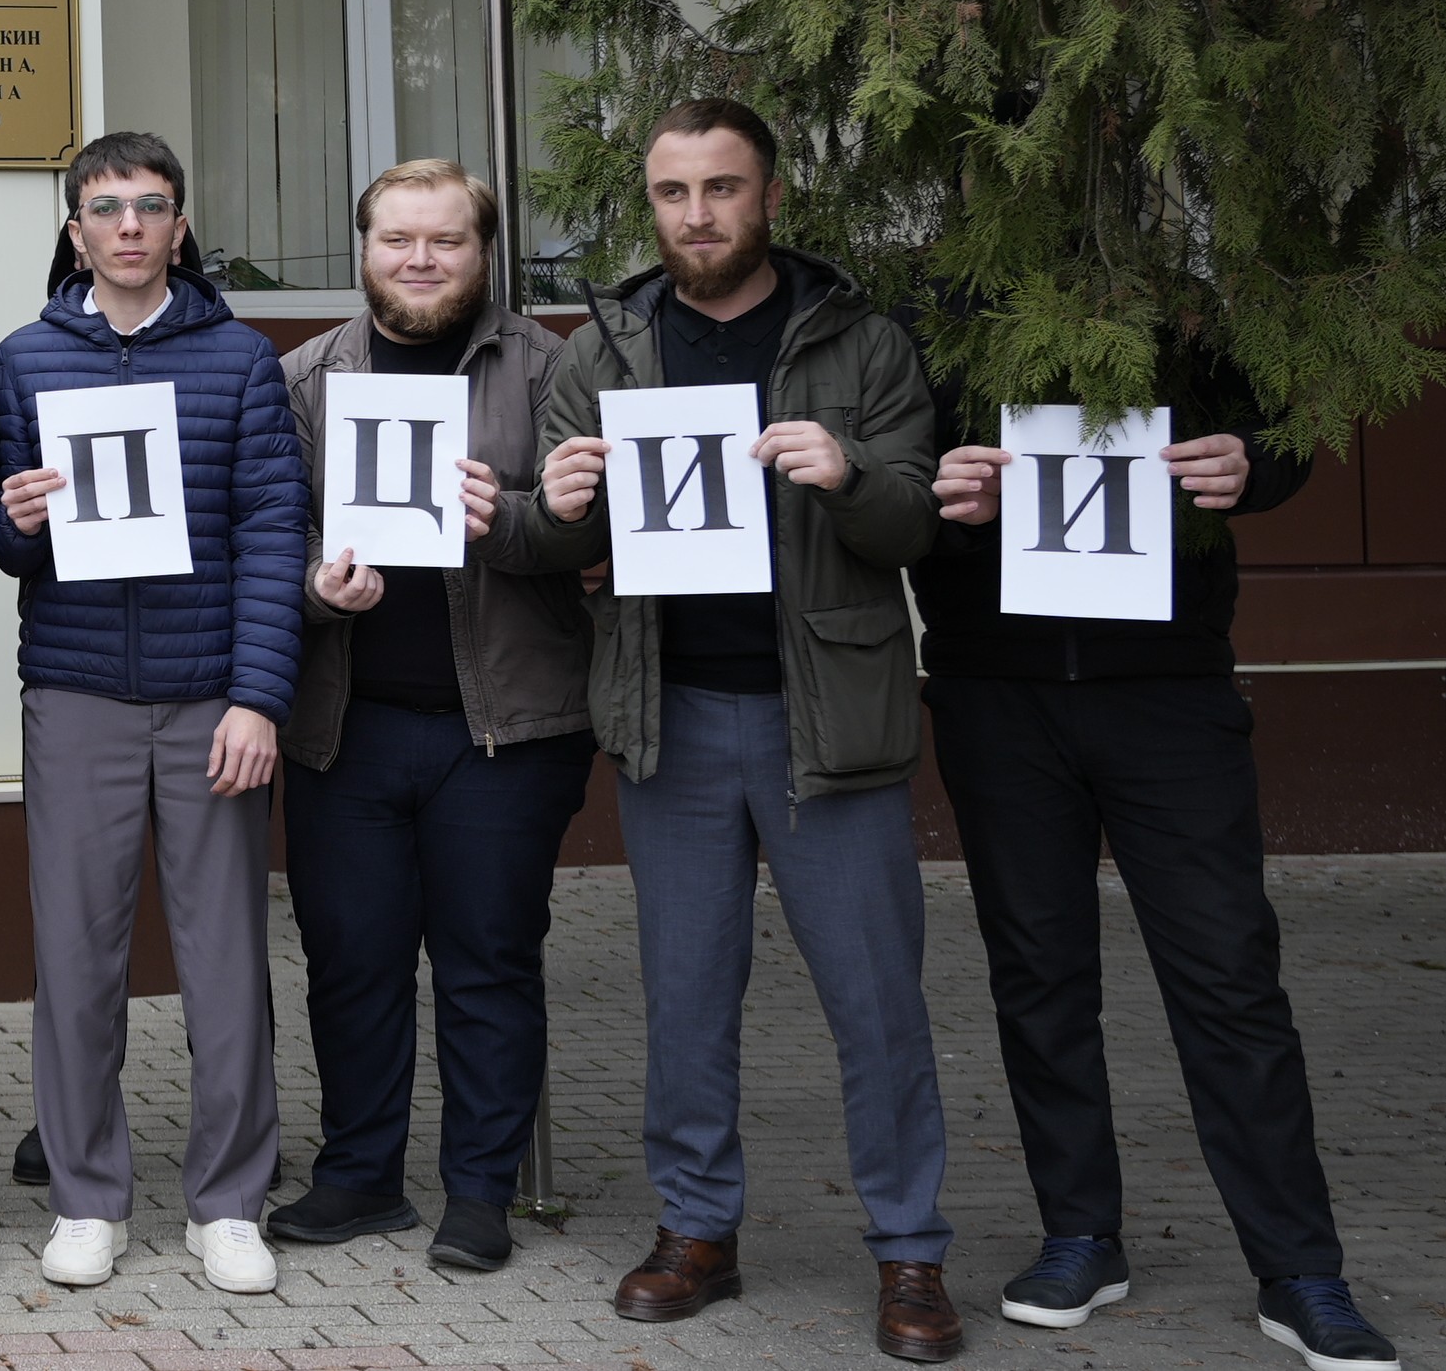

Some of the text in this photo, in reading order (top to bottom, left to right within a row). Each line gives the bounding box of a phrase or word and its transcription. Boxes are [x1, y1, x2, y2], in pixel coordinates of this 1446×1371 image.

[8, 85, 21, 100] А
[56, 427, 165, 524] П
[342, 417, 445, 535] Ц
[622, 433, 745, 533] И
[1021, 453, 1147, 556] И
